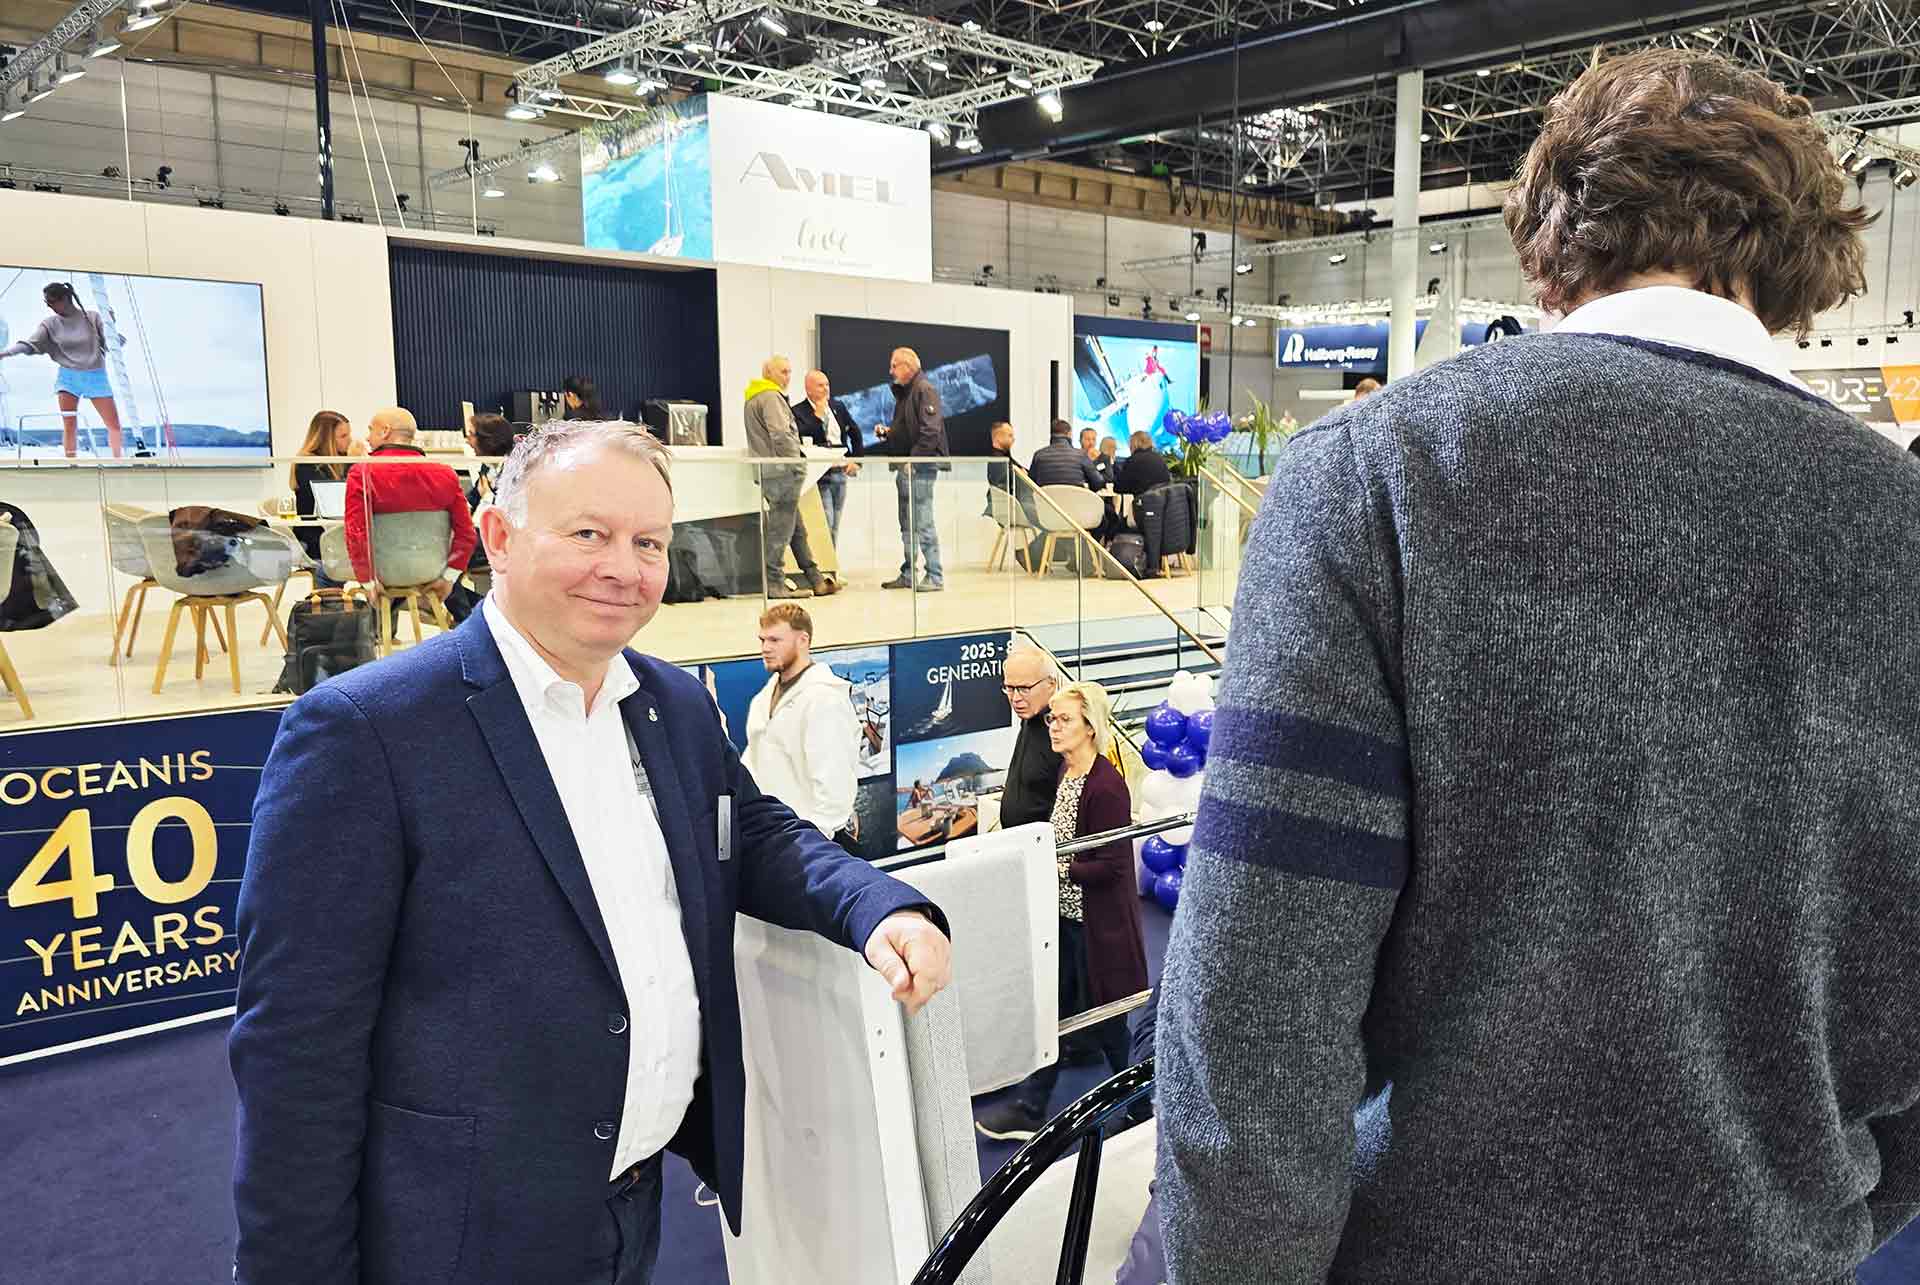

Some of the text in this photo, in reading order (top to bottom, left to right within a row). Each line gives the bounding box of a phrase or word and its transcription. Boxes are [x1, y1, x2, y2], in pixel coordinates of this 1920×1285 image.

[738, 151, 909, 207] AMEL
[927, 659, 1002, 684] GENERATI
[960, 641, 996, 661] 2025
[0, 750, 214, 805] OCEANIS
[8, 796, 218, 919] 40
[25, 906, 224, 977] YEARS
[16, 950, 241, 1016] ANNIVERSARY
